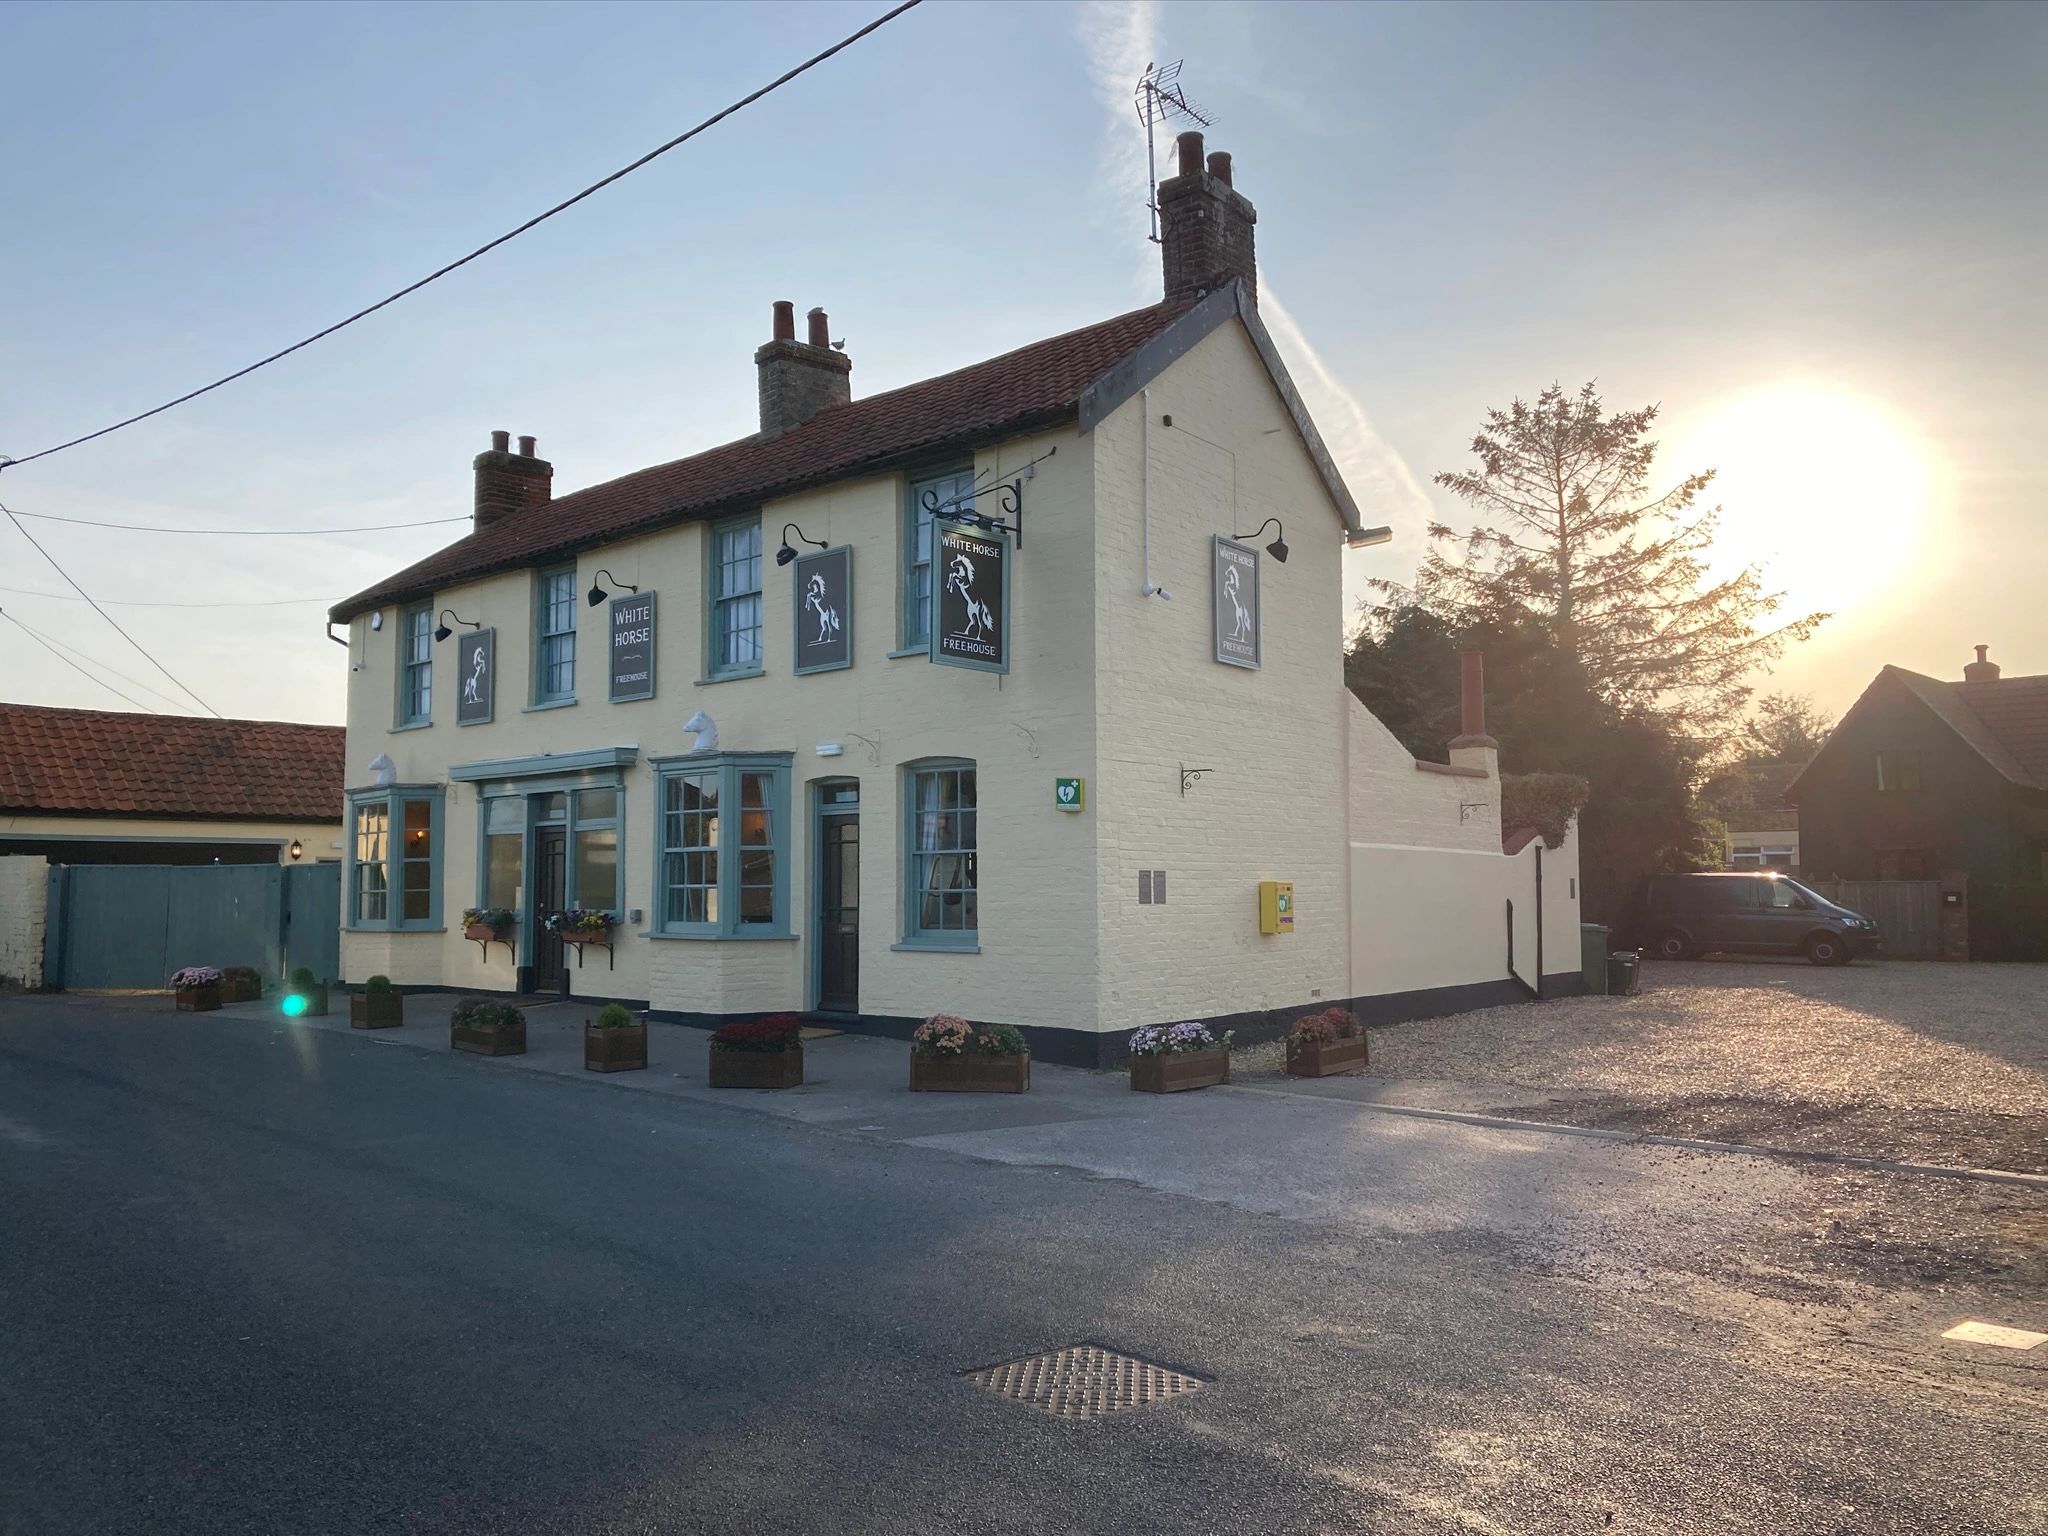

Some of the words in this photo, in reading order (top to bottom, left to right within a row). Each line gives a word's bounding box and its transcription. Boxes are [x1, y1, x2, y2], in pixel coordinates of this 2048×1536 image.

[941, 535, 971, 552] WHITE
[972, 543, 1000, 558] HORSE
[1219, 547, 1238, 563] WHITE
[615, 606, 650, 625] WHITE
[615, 627, 650, 647] HORSE
[943, 637, 996, 656] FREEHOUSE
[615, 671, 648, 684] FREEHOUSE
